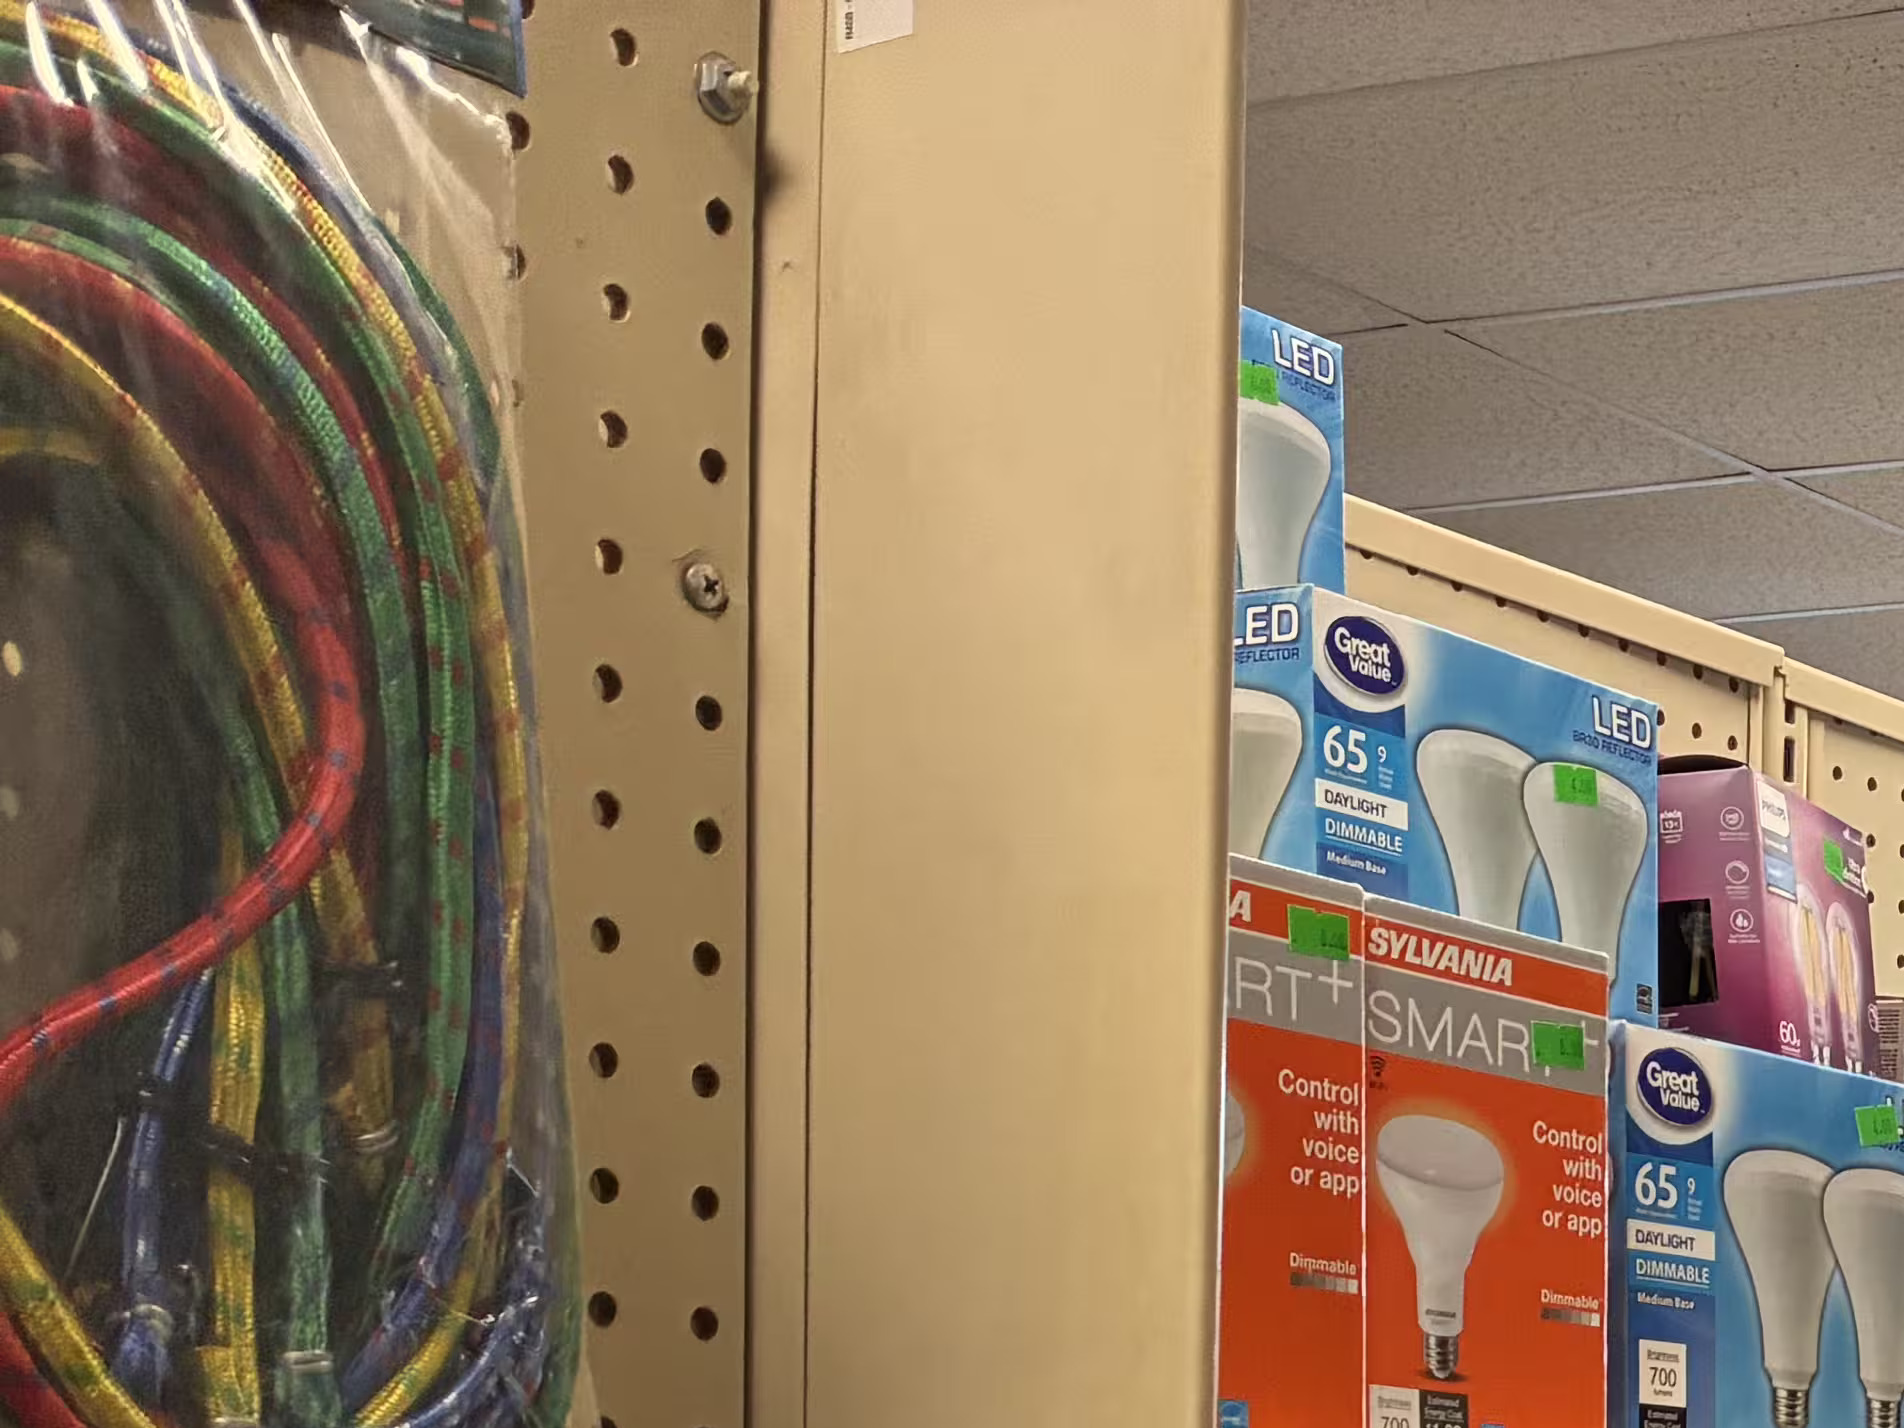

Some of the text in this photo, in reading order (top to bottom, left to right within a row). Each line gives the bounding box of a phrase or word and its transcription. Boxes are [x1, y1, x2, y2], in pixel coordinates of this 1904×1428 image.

[1271, 328, 1336, 387] LED
[1333, 626, 1391, 668] Great
[1348, 655, 1392, 685] Value
[1591, 693, 1652, 750] LED
[1322, 724, 1369, 774] 65
[1377, 745, 1388, 764] 9
[1324, 788, 1389, 819] DAYLIGHT
[1325, 817, 1404, 853] DIMMABLE
[1326, 850, 1365, 873] Medium
[1366, 926, 1514, 988] SYLVANIA
[1277, 1067, 1361, 1107] Control
[1645, 1061, 1700, 1095] Great
[1659, 1087, 1701, 1114] Value
[1313, 1109, 1360, 1136] with
[1531, 1119, 1603, 1156] Control
[1302, 1135, 1360, 1166] voice
[1290, 1164, 1361, 1201] or app
[1562, 1156, 1602, 1182] with
[1552, 1181, 1603, 1210] voice
[1634, 1161, 1679, 1209] 65
[1687, 1177, 1696, 1195] 9
[1541, 1208, 1603, 1239] or app
[1634, 1228, 1697, 1253] DAYLIGHT
[1289, 1252, 1357, 1277] Dimmable
[1635, 1258, 1710, 1285] DIMMABLE
[1540, 1288, 1600, 1311] Dimmable
[1637, 1292, 1674, 1309] Medium
[1649, 1366, 1678, 1389] 700
